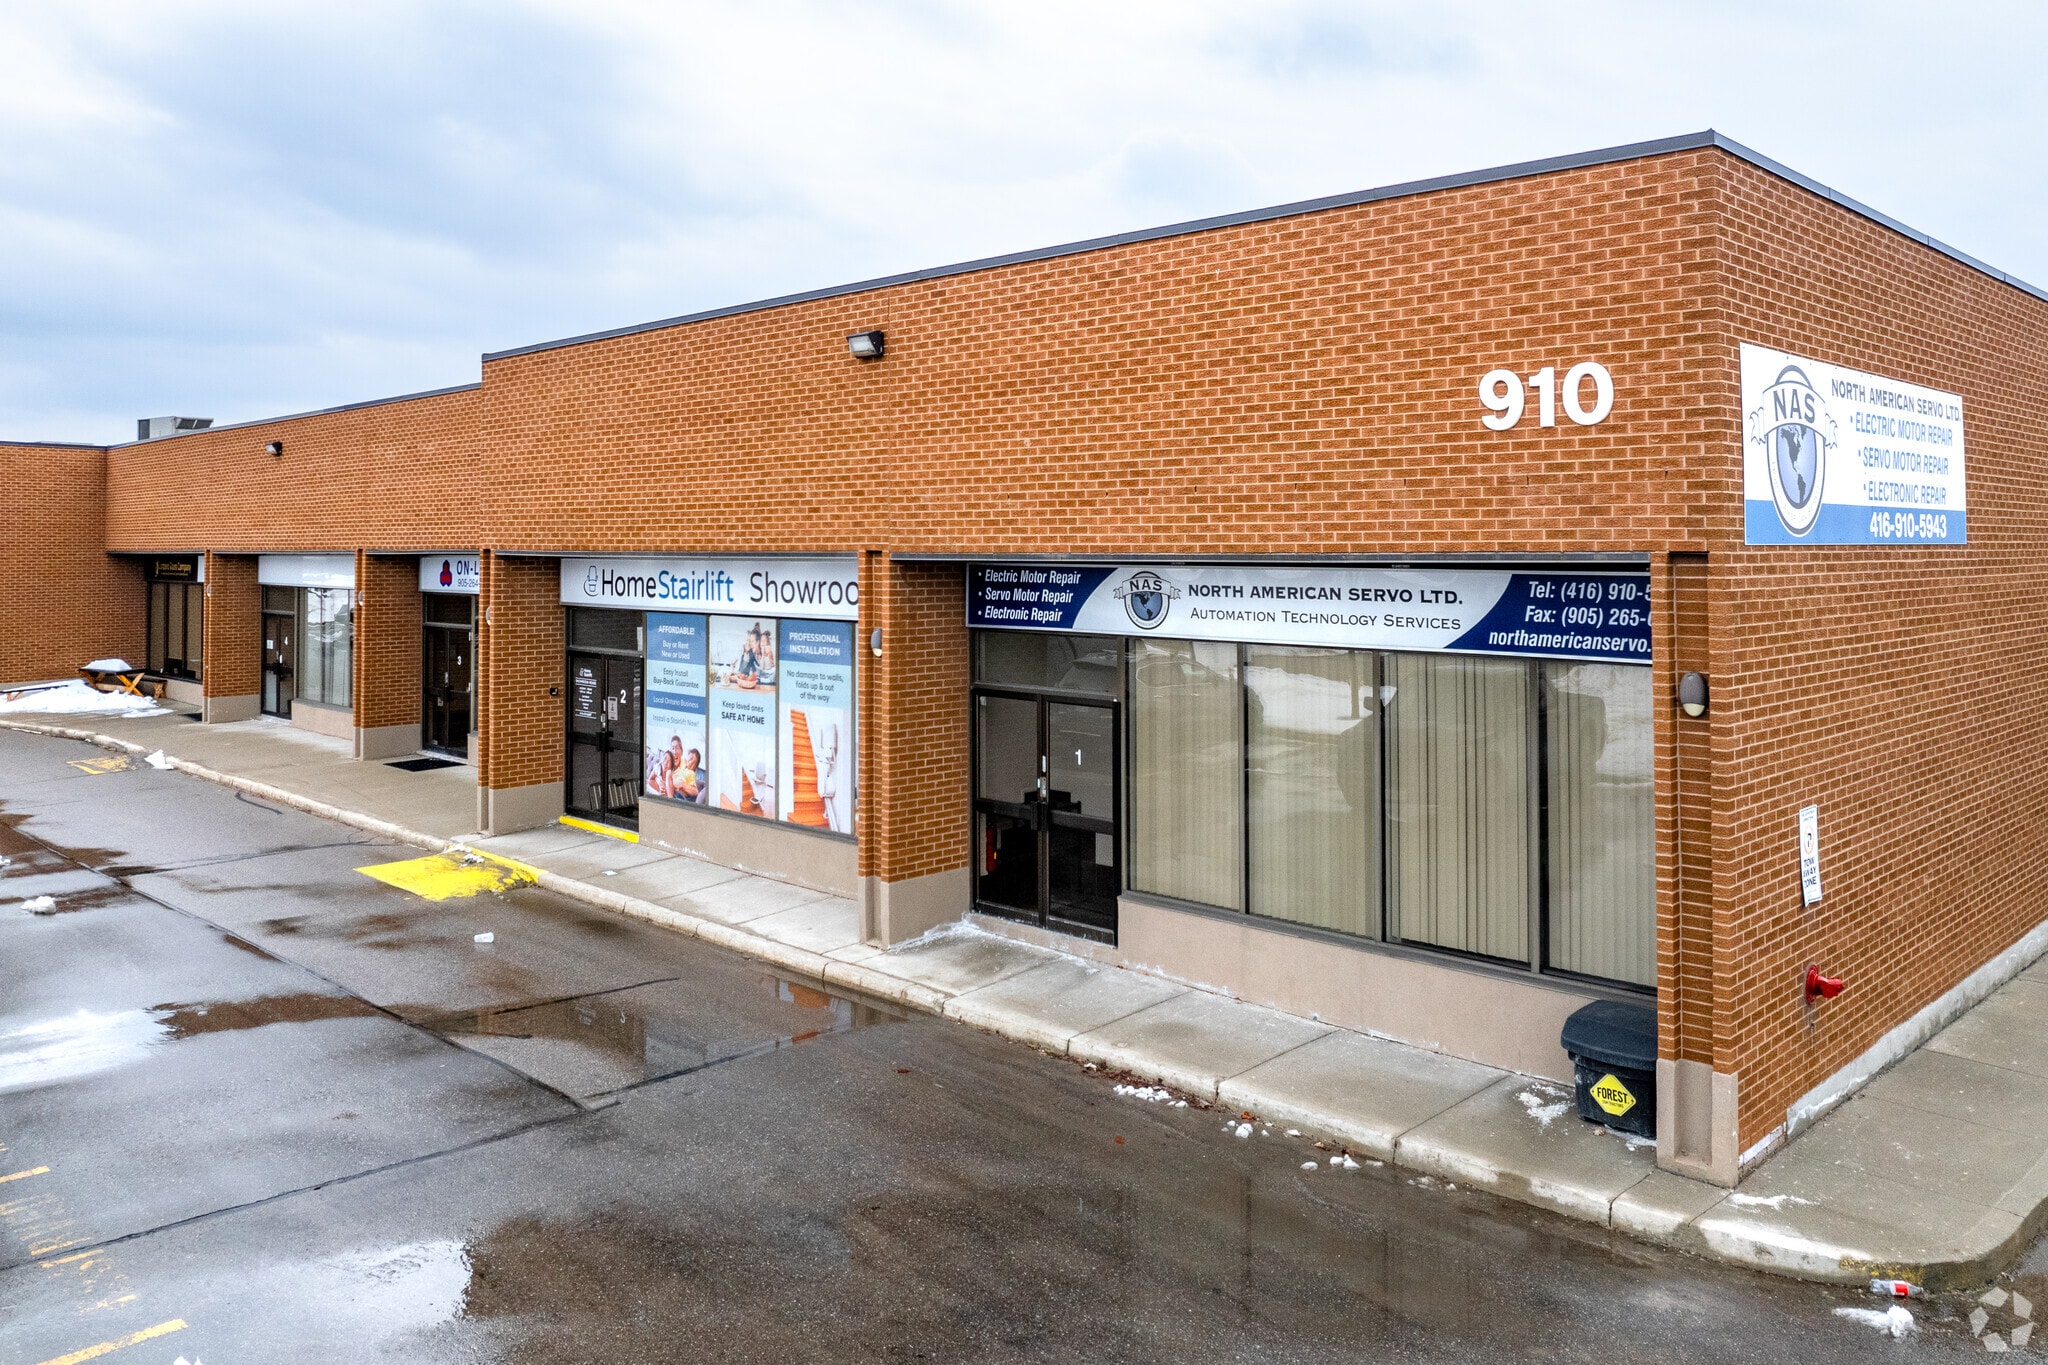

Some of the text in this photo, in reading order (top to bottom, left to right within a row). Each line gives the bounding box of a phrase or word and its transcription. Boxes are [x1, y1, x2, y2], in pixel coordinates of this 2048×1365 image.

[1478, 361, 1614, 431] 910
[1831, 378, 1866, 403] NORTH
[1869, 388, 1915, 413] AMERICAN
[1917, 398, 1944, 419] SERVO
[1773, 388, 1816, 424] NAS
[1855, 411, 1953, 447] ELECTRIC MOTOR REPAIR
[1863, 446, 1949, 476] SERVO MOTOR REPAIR
[1868, 480, 1946, 505] ELECTRONIC REPAIR
[1870, 511, 1947, 538] 416-910-5943
[985, 569, 1081, 586] Electric Motor Repair
[602, 569, 734, 602] HomeStairlift
[1129, 580, 1162, 591] NAS
[1529, 581, 1556, 598] Tel:
[1561, 582, 1602, 603] (416)
[985, 587, 1073, 605] Servo Motor Repair
[1188, 584, 1463, 605] NORTH AMERICAN SERVO LTD.
[984, 606, 1063, 624] Electronic Repair
[1525, 606, 1556, 623] Fax:
[1562, 607, 1603, 628] (905)
[662, 640, 671, 649] Buy
[678, 641, 689, 649] Rent
[789, 632, 840, 643] PROFESSIONAL
[661, 650, 671, 658] New
[679, 652, 690, 660] Used
[789, 644, 840, 656] INSTALLATION
[457, 656, 462, 665] 3
[663, 668, 674, 677] Easy
[786, 669, 794, 678] No
[796, 670, 818, 681] damage
[653, 677, 699, 689] Buy-Back Guarantee
[795, 681, 809, 689] folds
[810, 684, 818, 692] up
[825, 684, 834, 692] out
[620, 689, 627, 704] 2
[653, 696, 699, 709] Local Ontario Business
[800, 691, 830, 703] of the way
[722, 700, 764, 713] Keep loved ones
[721, 711, 765, 725] SAFE AT HOME
[1075, 749, 1082, 765] 1
[1804, 856, 1815, 867] TOW
[1597, 1087, 1628, 1104] FOREST
